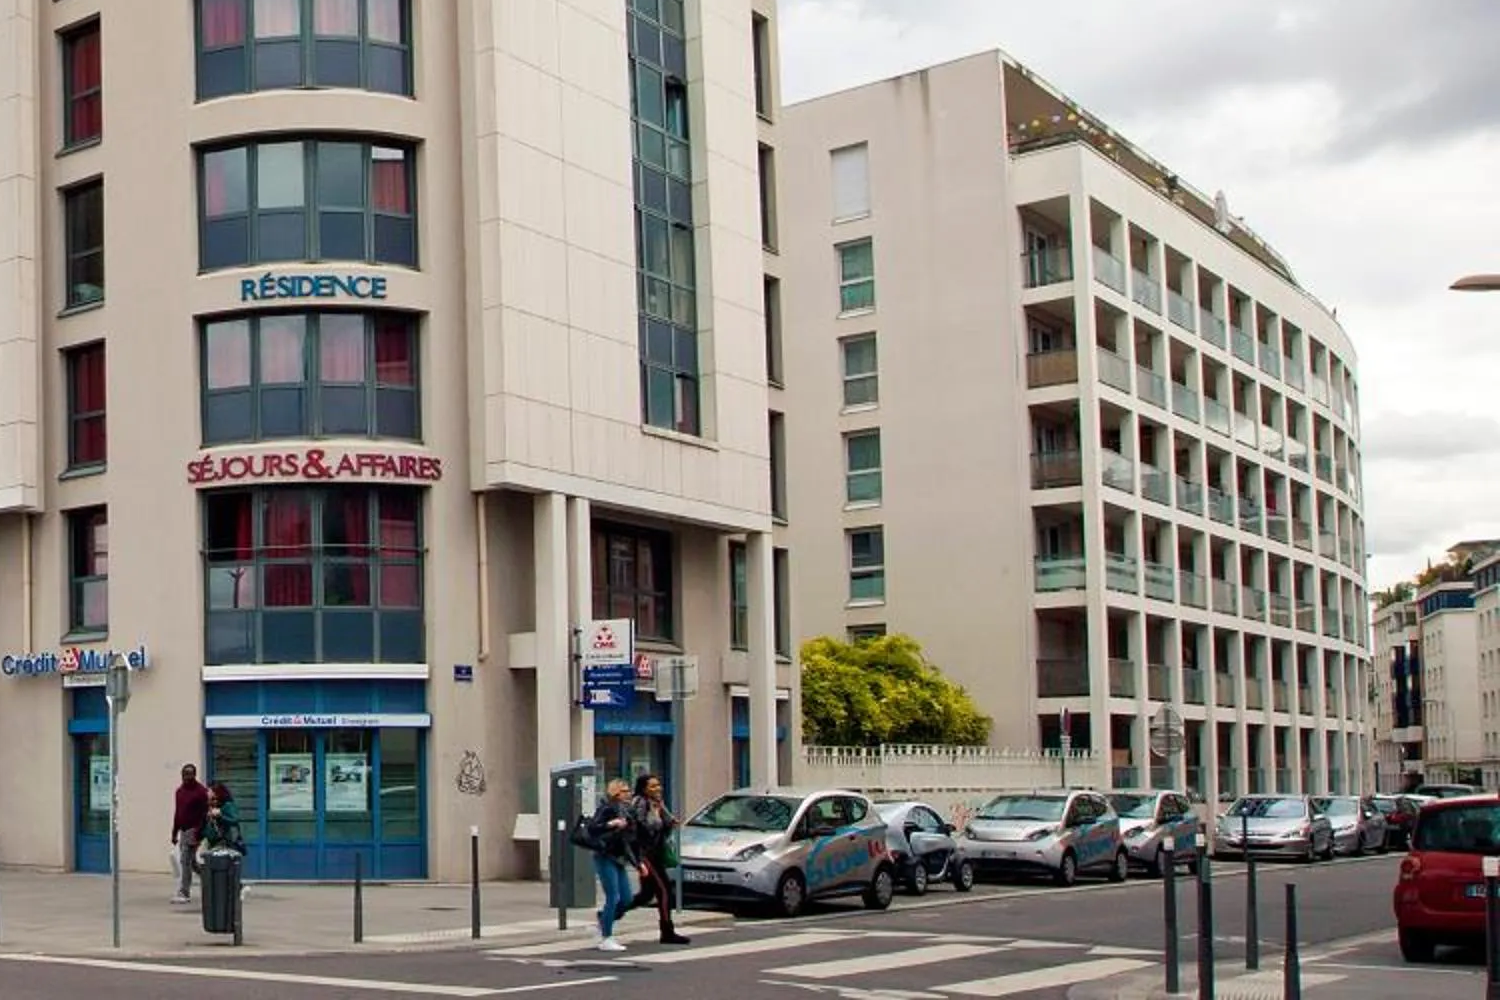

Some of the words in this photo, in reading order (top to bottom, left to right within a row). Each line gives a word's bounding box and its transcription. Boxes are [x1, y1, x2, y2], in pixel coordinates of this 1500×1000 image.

[241, 272, 388, 301] RÉSIDENCE
[187, 454, 299, 484] SÉJOURS
[302, 449, 335, 479] &
[336, 453, 442, 481] AFFAIRES
[1, 652, 57, 676] Crédit
